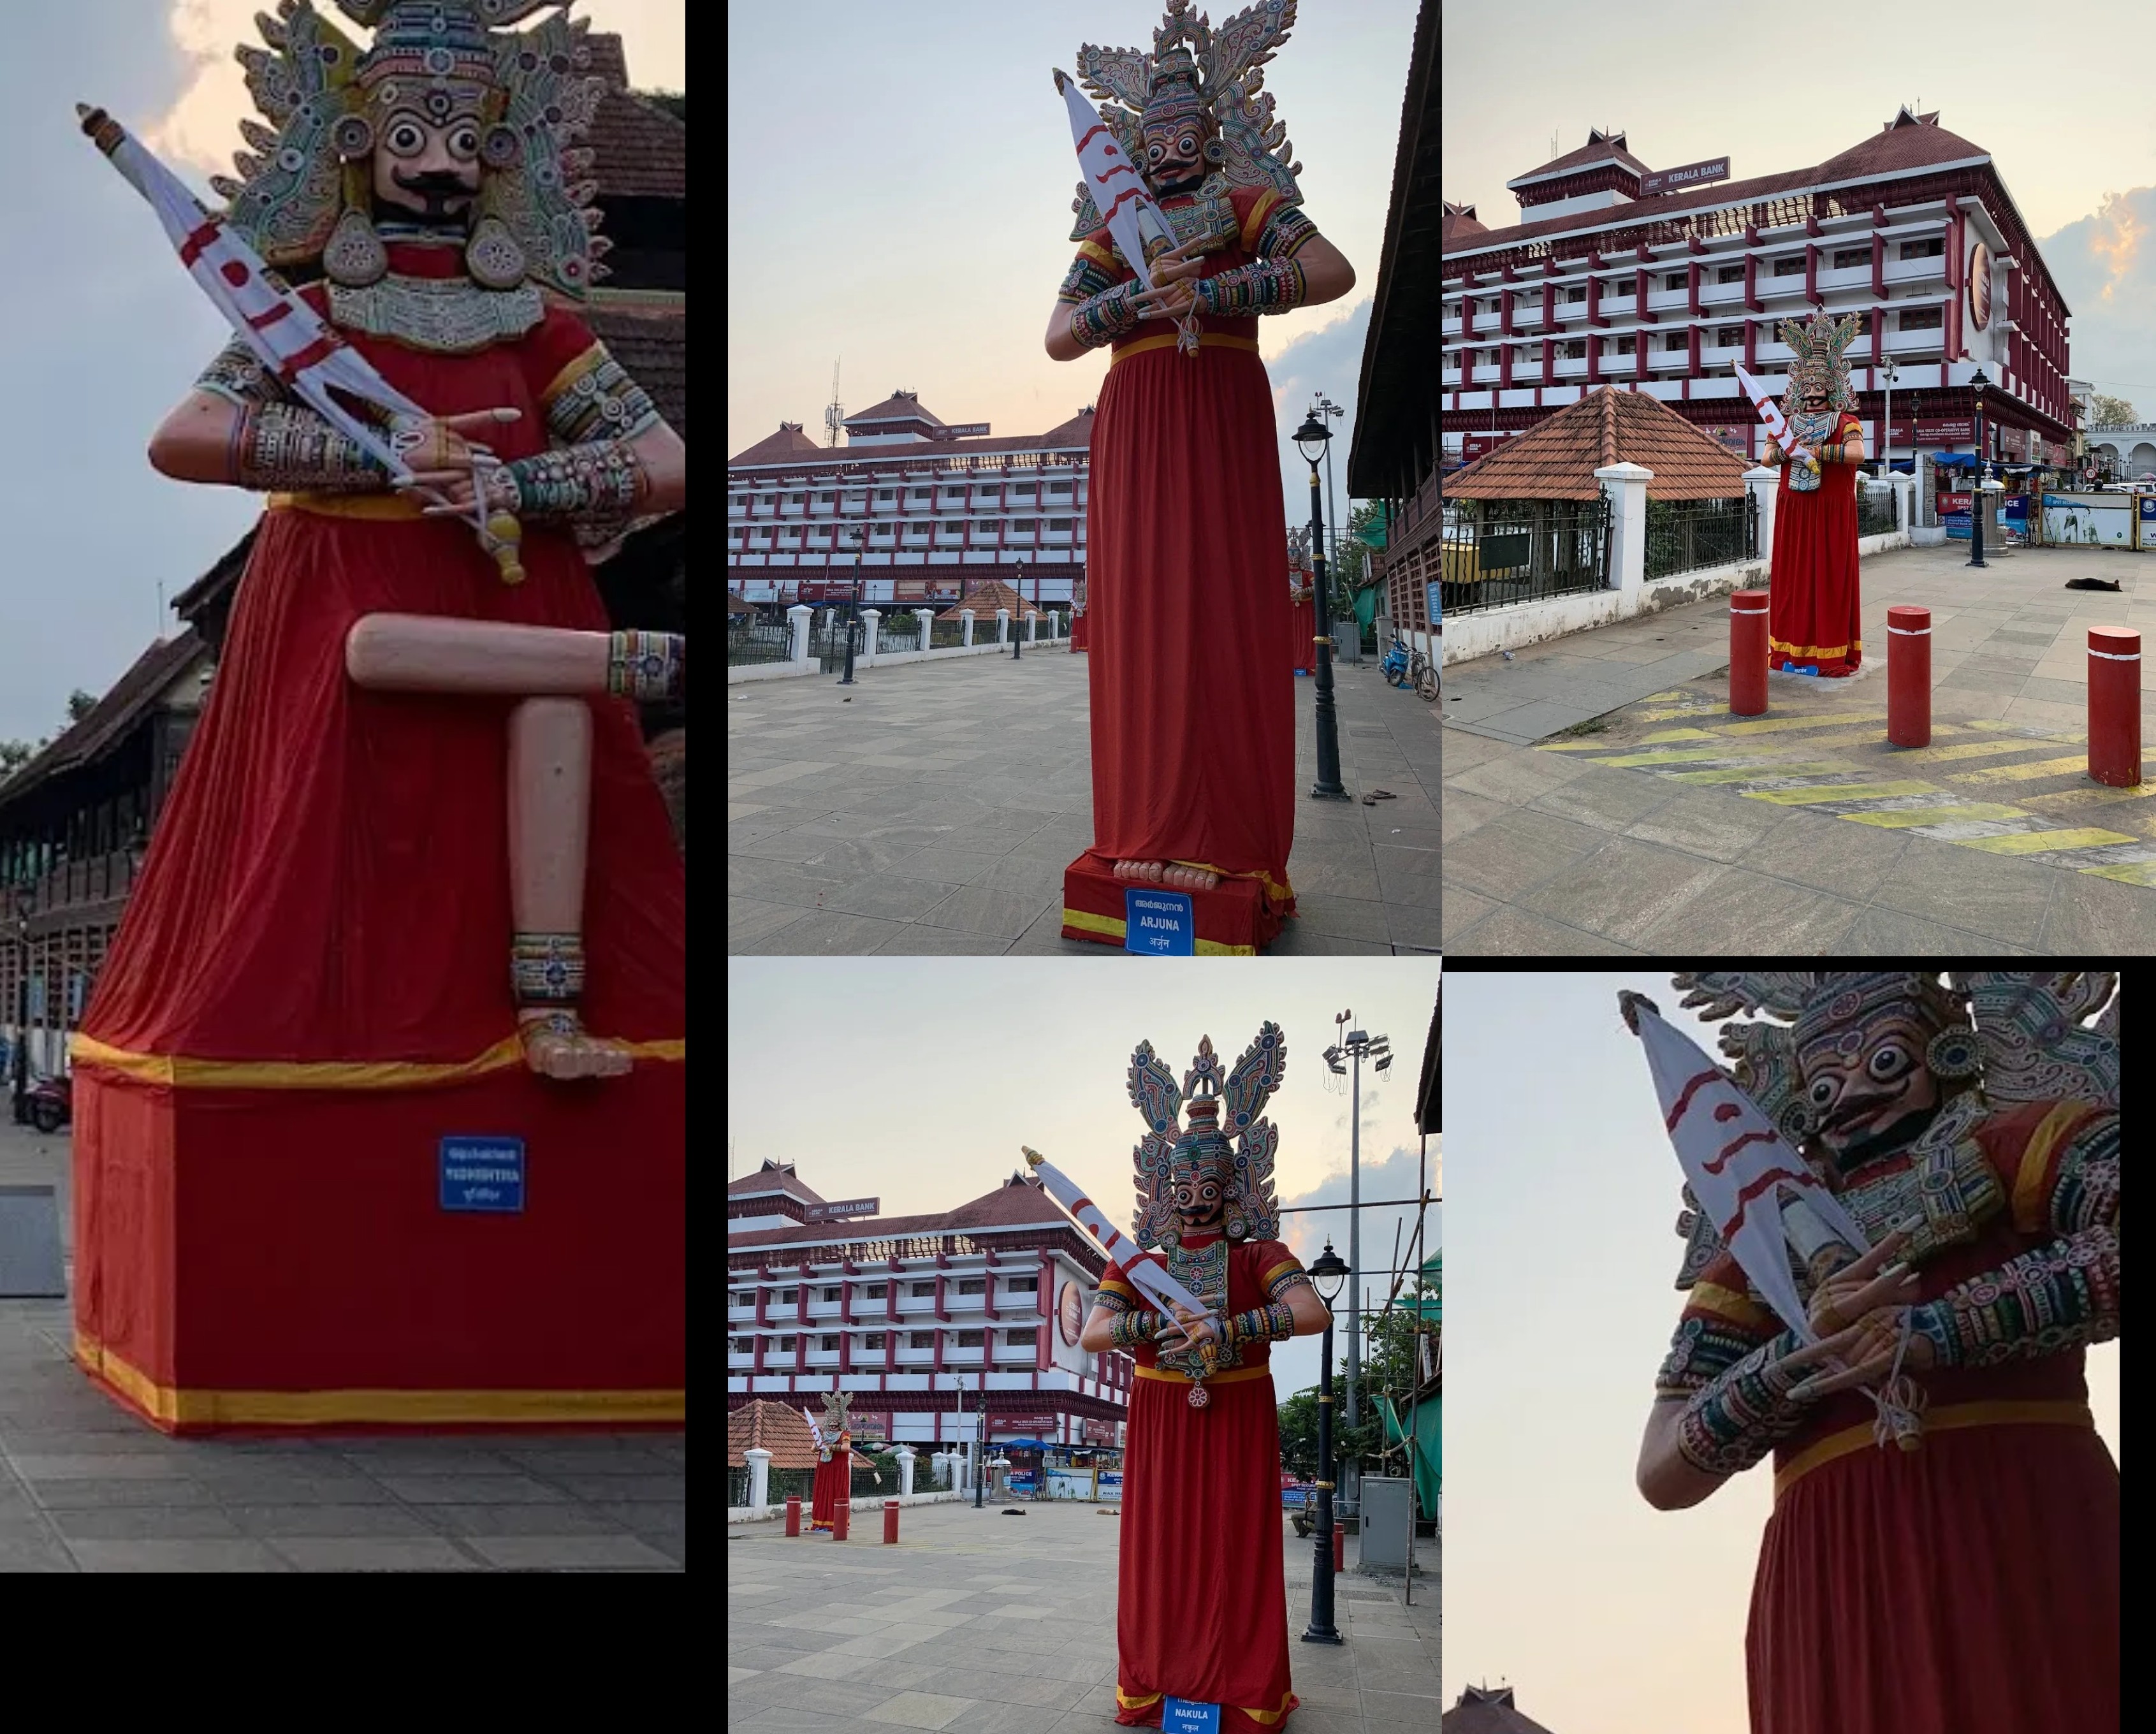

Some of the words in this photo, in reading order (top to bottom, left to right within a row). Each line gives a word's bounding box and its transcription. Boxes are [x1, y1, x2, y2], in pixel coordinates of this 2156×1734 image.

[1668, 168, 1699, 184] KERALA
[1700, 163, 1724, 177] BANK
[1140, 915, 1180, 931] ARJUNA
[1149, 935, 1170, 951] अर्जुन
[829, 1204, 854, 1214] KERALA
[855, 1202, 875, 1211] BANK
[1175, 1708, 1208, 1719] NAKULA
[1182, 1723, 1199, 1733] नकुल
